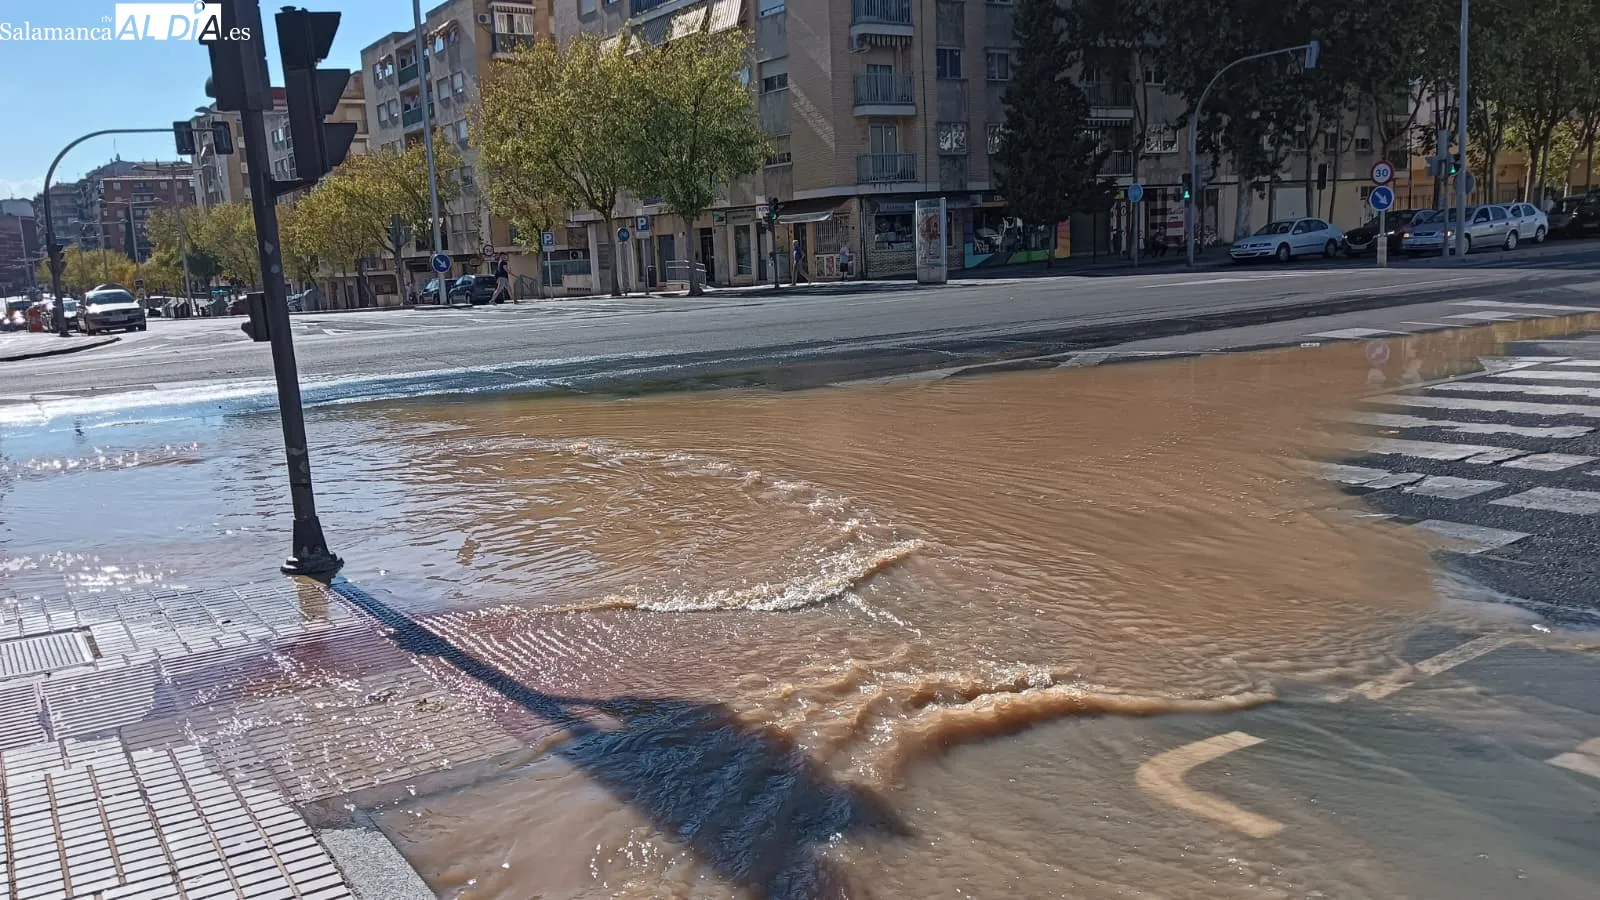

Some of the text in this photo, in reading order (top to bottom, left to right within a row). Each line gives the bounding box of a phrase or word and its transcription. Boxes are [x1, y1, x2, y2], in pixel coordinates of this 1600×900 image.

[1375, 168, 1389, 178] 30
[637, 217, 647, 229] P
[543, 233, 552, 243] P
